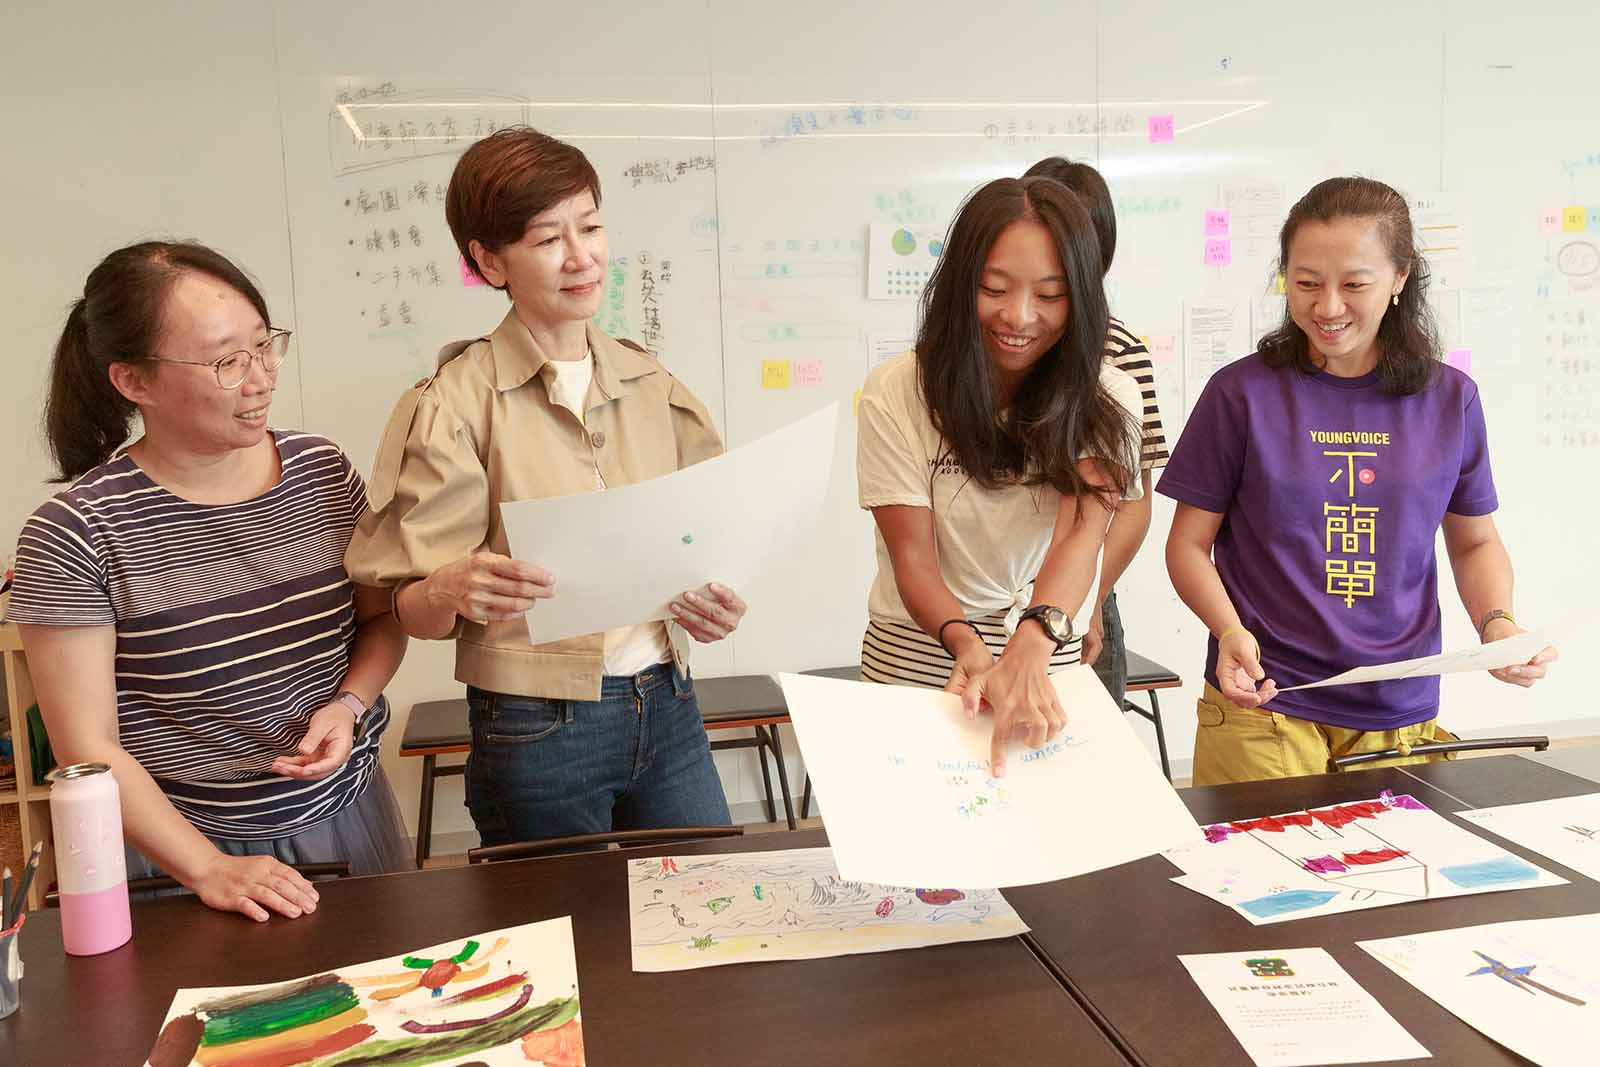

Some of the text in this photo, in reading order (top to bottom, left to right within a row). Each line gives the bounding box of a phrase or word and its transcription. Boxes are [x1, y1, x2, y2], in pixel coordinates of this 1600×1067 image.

[1310, 431, 1390, 445] YOUNGVOICE
[1323, 451, 1380, 609] 不簡單
